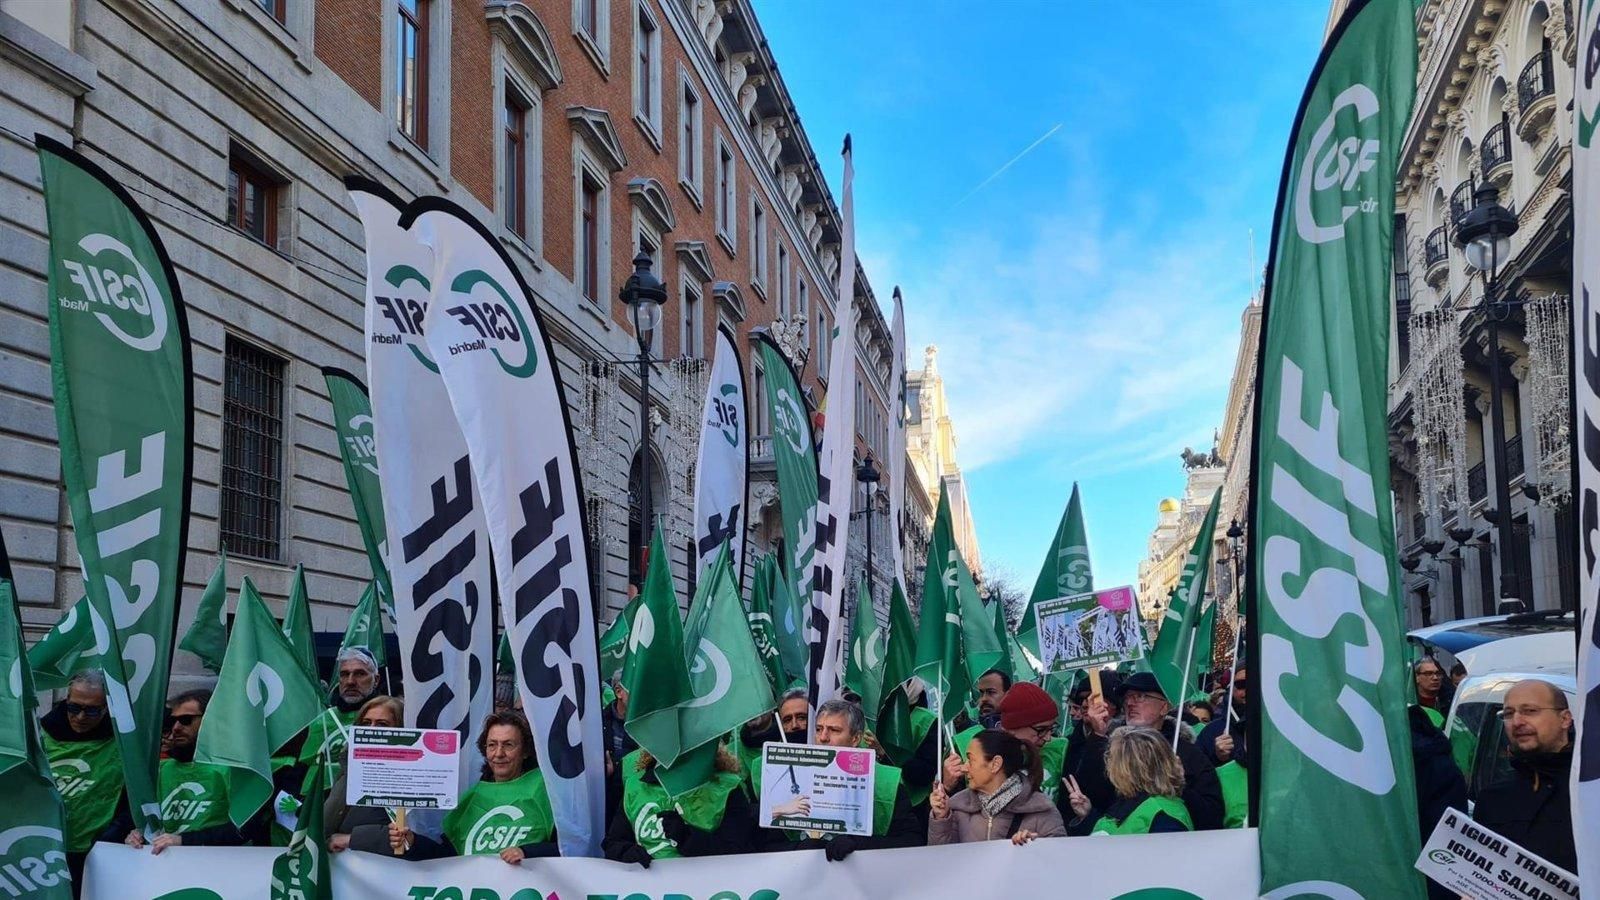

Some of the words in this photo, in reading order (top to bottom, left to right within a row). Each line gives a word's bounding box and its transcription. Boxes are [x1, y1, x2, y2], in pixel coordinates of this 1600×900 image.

[1260, 353, 1397, 796] CSIF
[162, 799, 212, 820] CSIF
[475, 826, 532, 851] CSIF
[1444, 814, 1457, 829] A
[1460, 823, 1509, 858] IGUAL
[1446, 839, 1494, 874] IGUAL
[1497, 869, 1558, 900] SALAR
